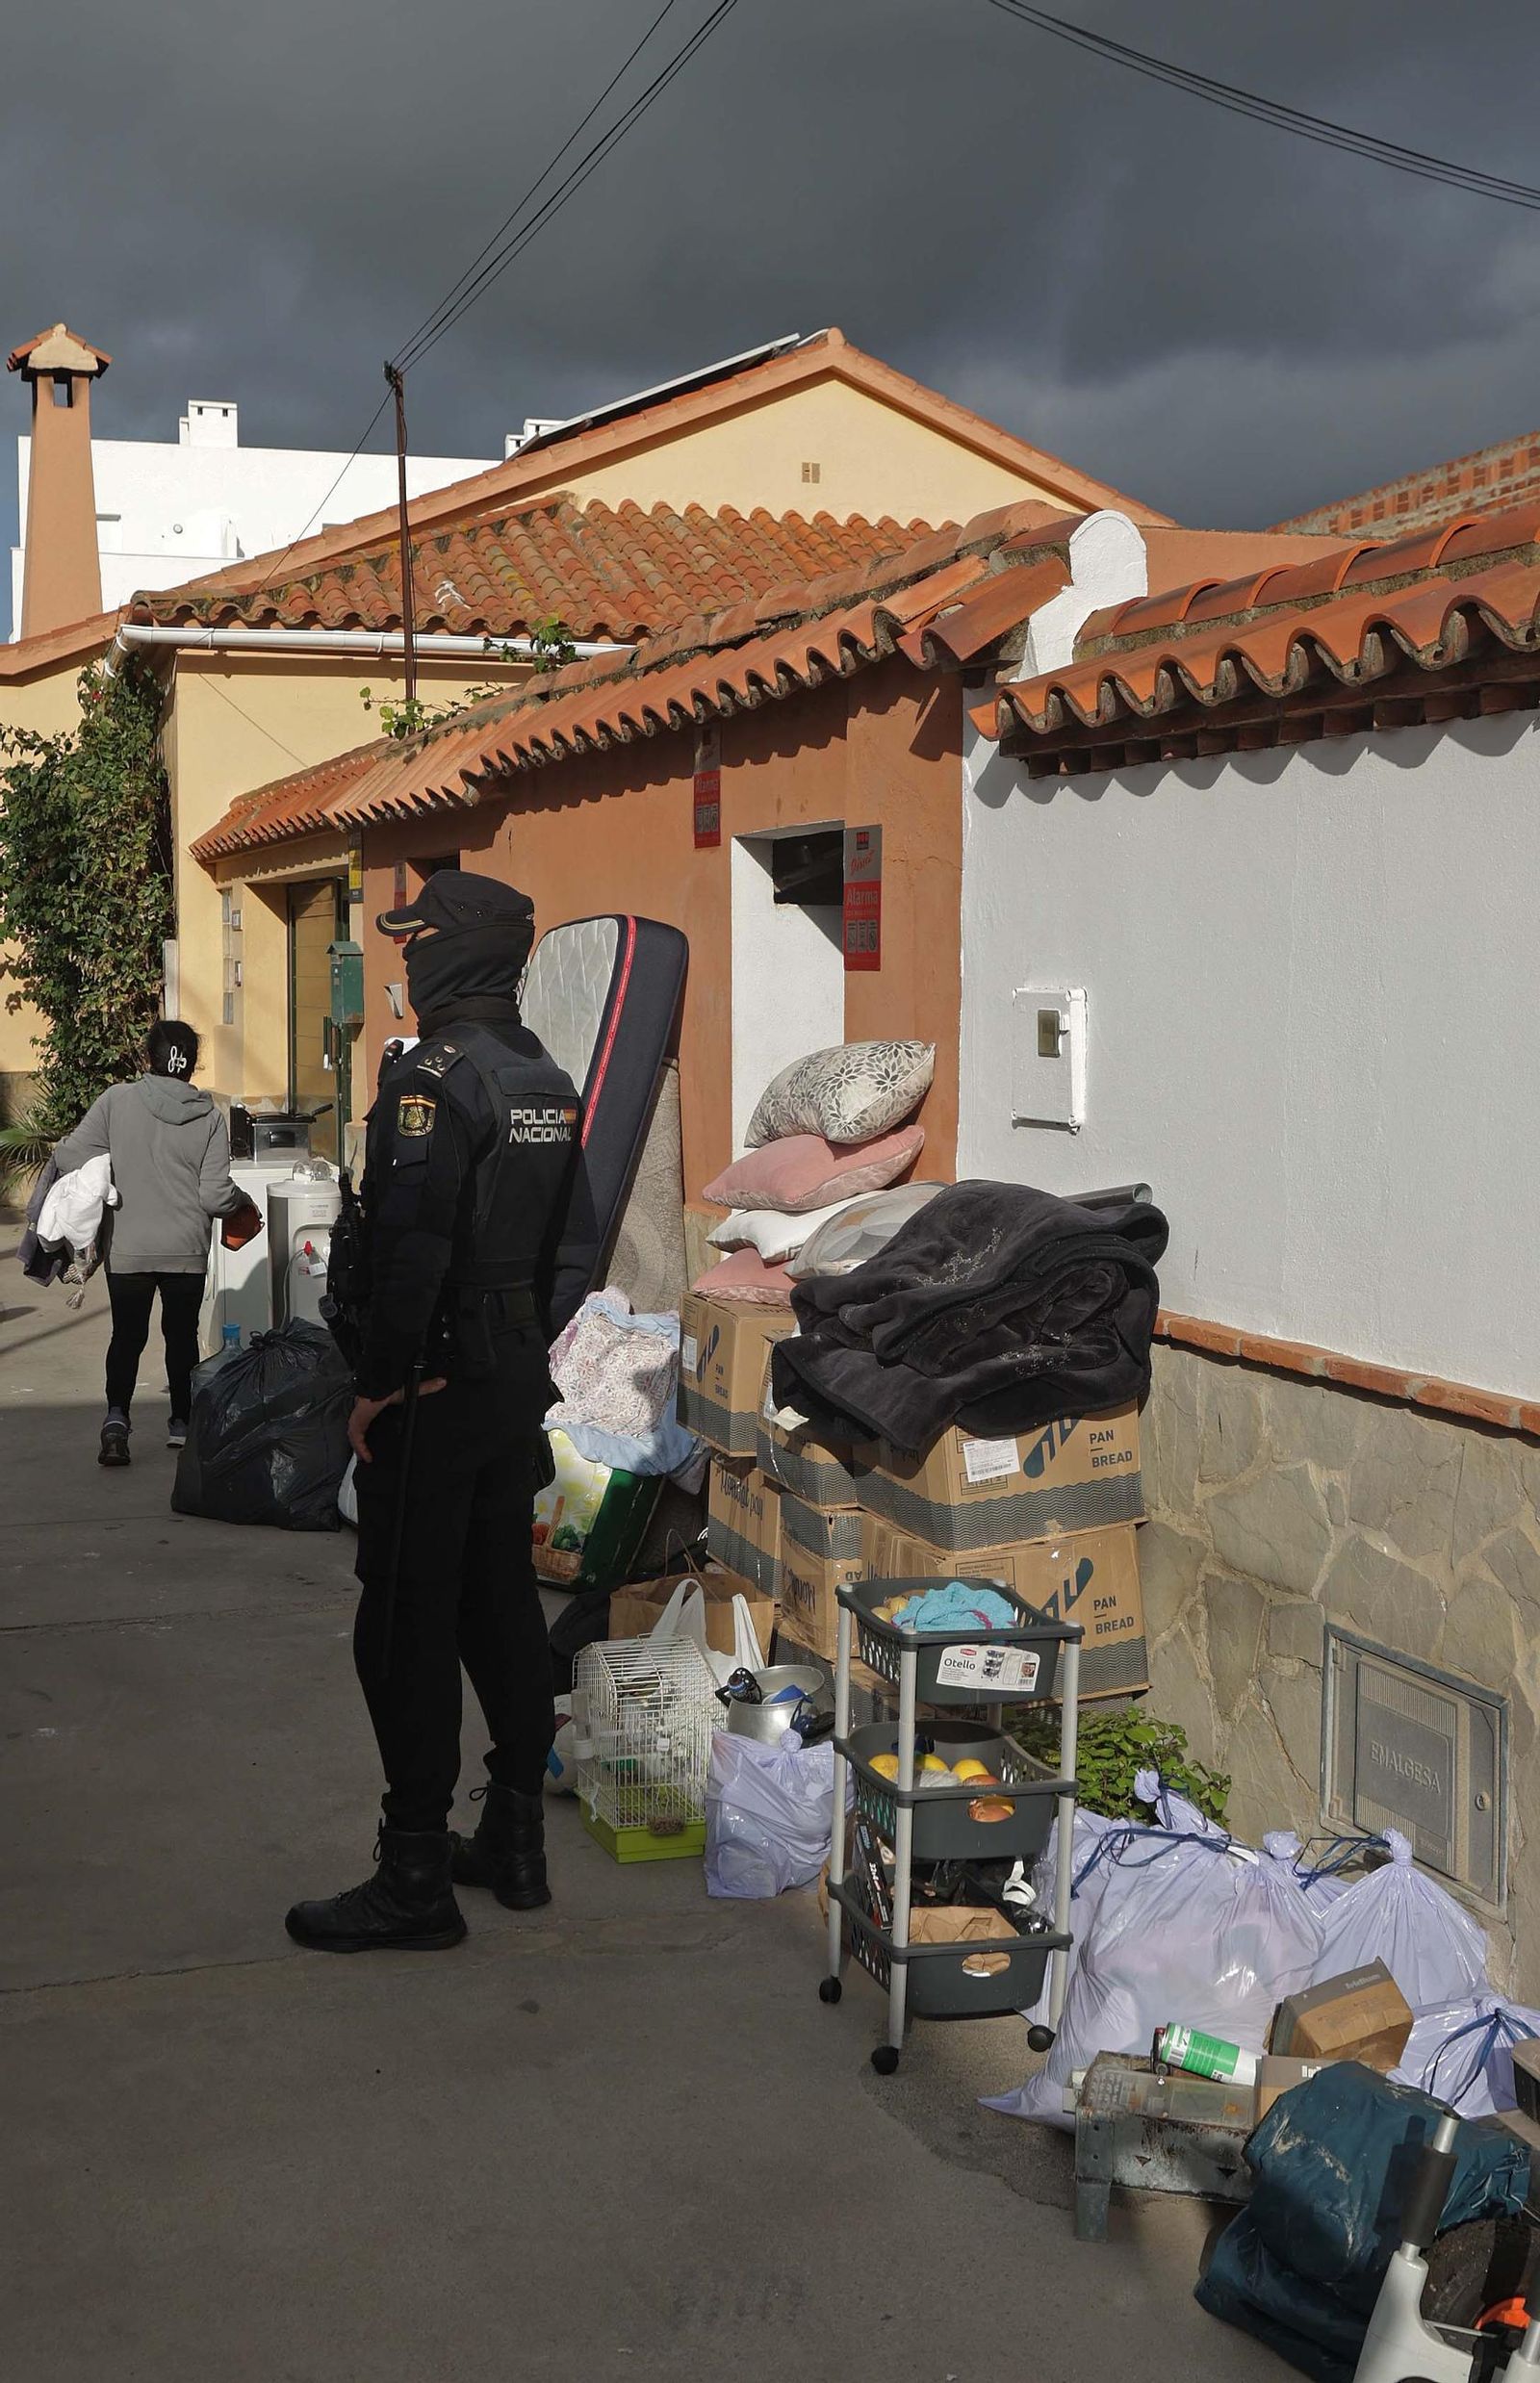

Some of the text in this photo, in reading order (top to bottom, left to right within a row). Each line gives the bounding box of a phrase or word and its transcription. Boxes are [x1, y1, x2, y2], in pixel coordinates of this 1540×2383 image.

[847, 886, 879, 905] Alarma
[510, 1109, 566, 1124] POLICIA
[508, 1126, 572, 1143] NACIONAL
[1090, 1429, 1115, 1445] PAN
[1091, 1450, 1133, 1468] BREAD
[1093, 1596, 1117, 1611] PAN
[1095, 1617, 1134, 1634] BREAD
[944, 1657, 976, 1671] Otello
[1371, 1739, 1442, 1795] EMALGESA
